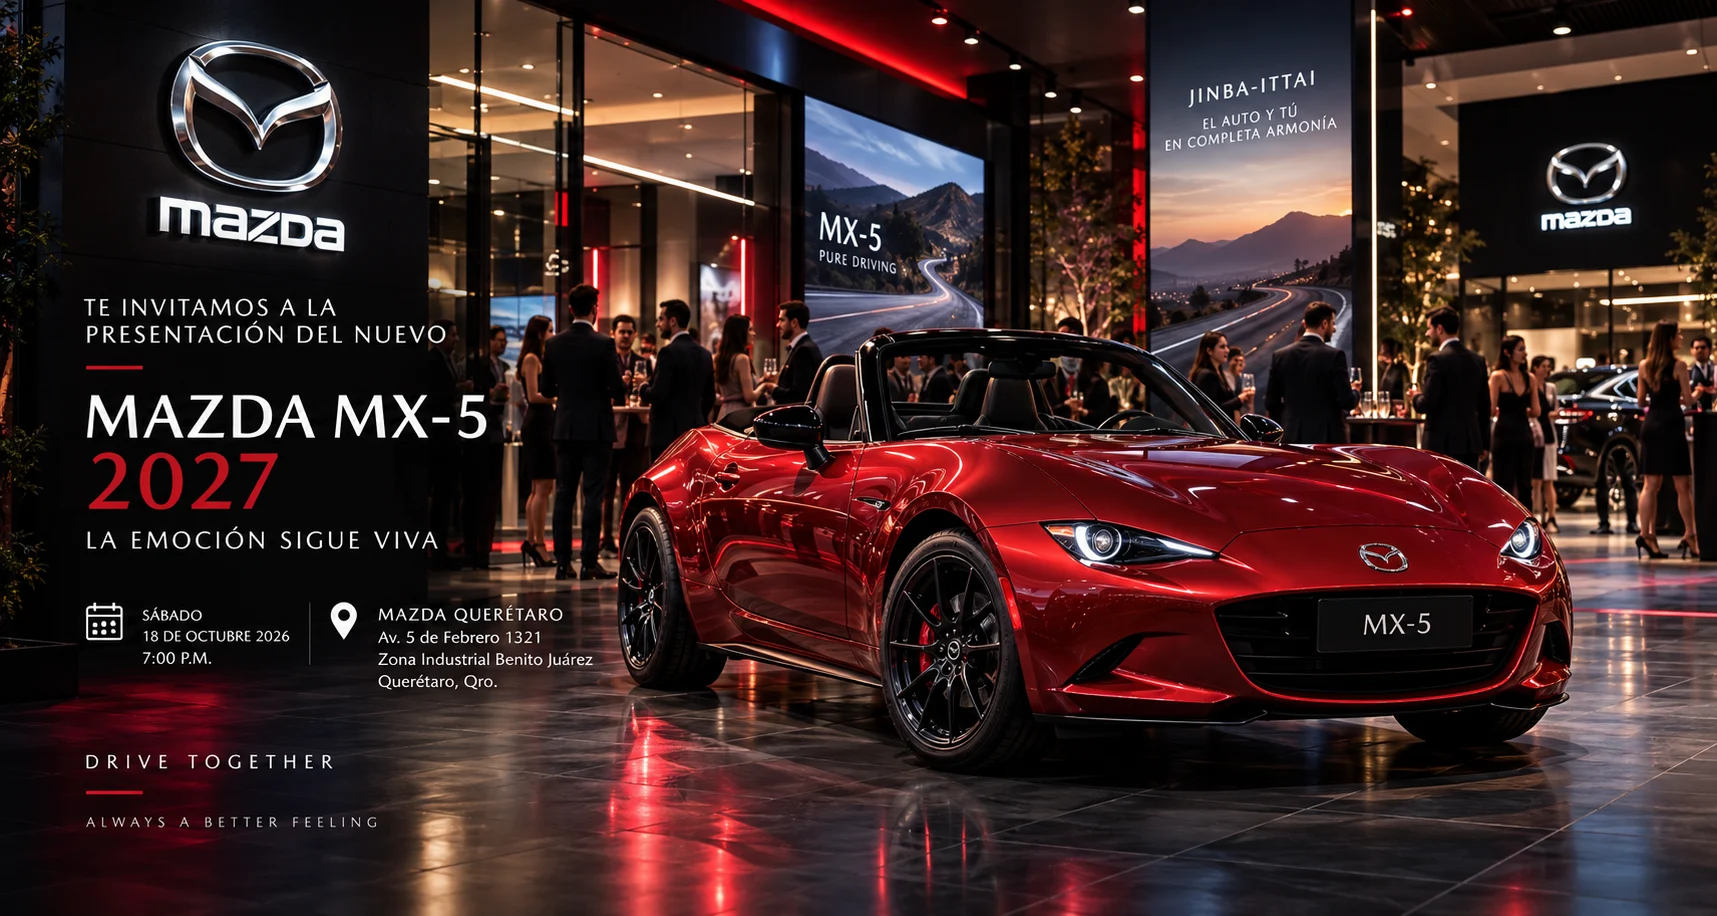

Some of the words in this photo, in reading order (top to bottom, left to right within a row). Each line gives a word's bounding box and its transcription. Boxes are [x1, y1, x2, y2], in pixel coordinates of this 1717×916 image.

[1188, 69, 1316, 108] JINBA-ITTAI
[1202, 117, 1217, 130] EL
[1221, 110, 1261, 128] AUTO
[1265, 108, 1275, 122] Y
[1279, 101, 1298, 119] TÚ
[1164, 138, 1182, 152] EN
[1187, 127, 1261, 149] COMPLETA
[1265, 114, 1338, 138] ARMONÍA
[819, 211, 882, 252] MX-5
[818, 249, 848, 266] PURE
[852, 255, 897, 275] DRIVING
[1363, 612, 1431, 636] MX-5
